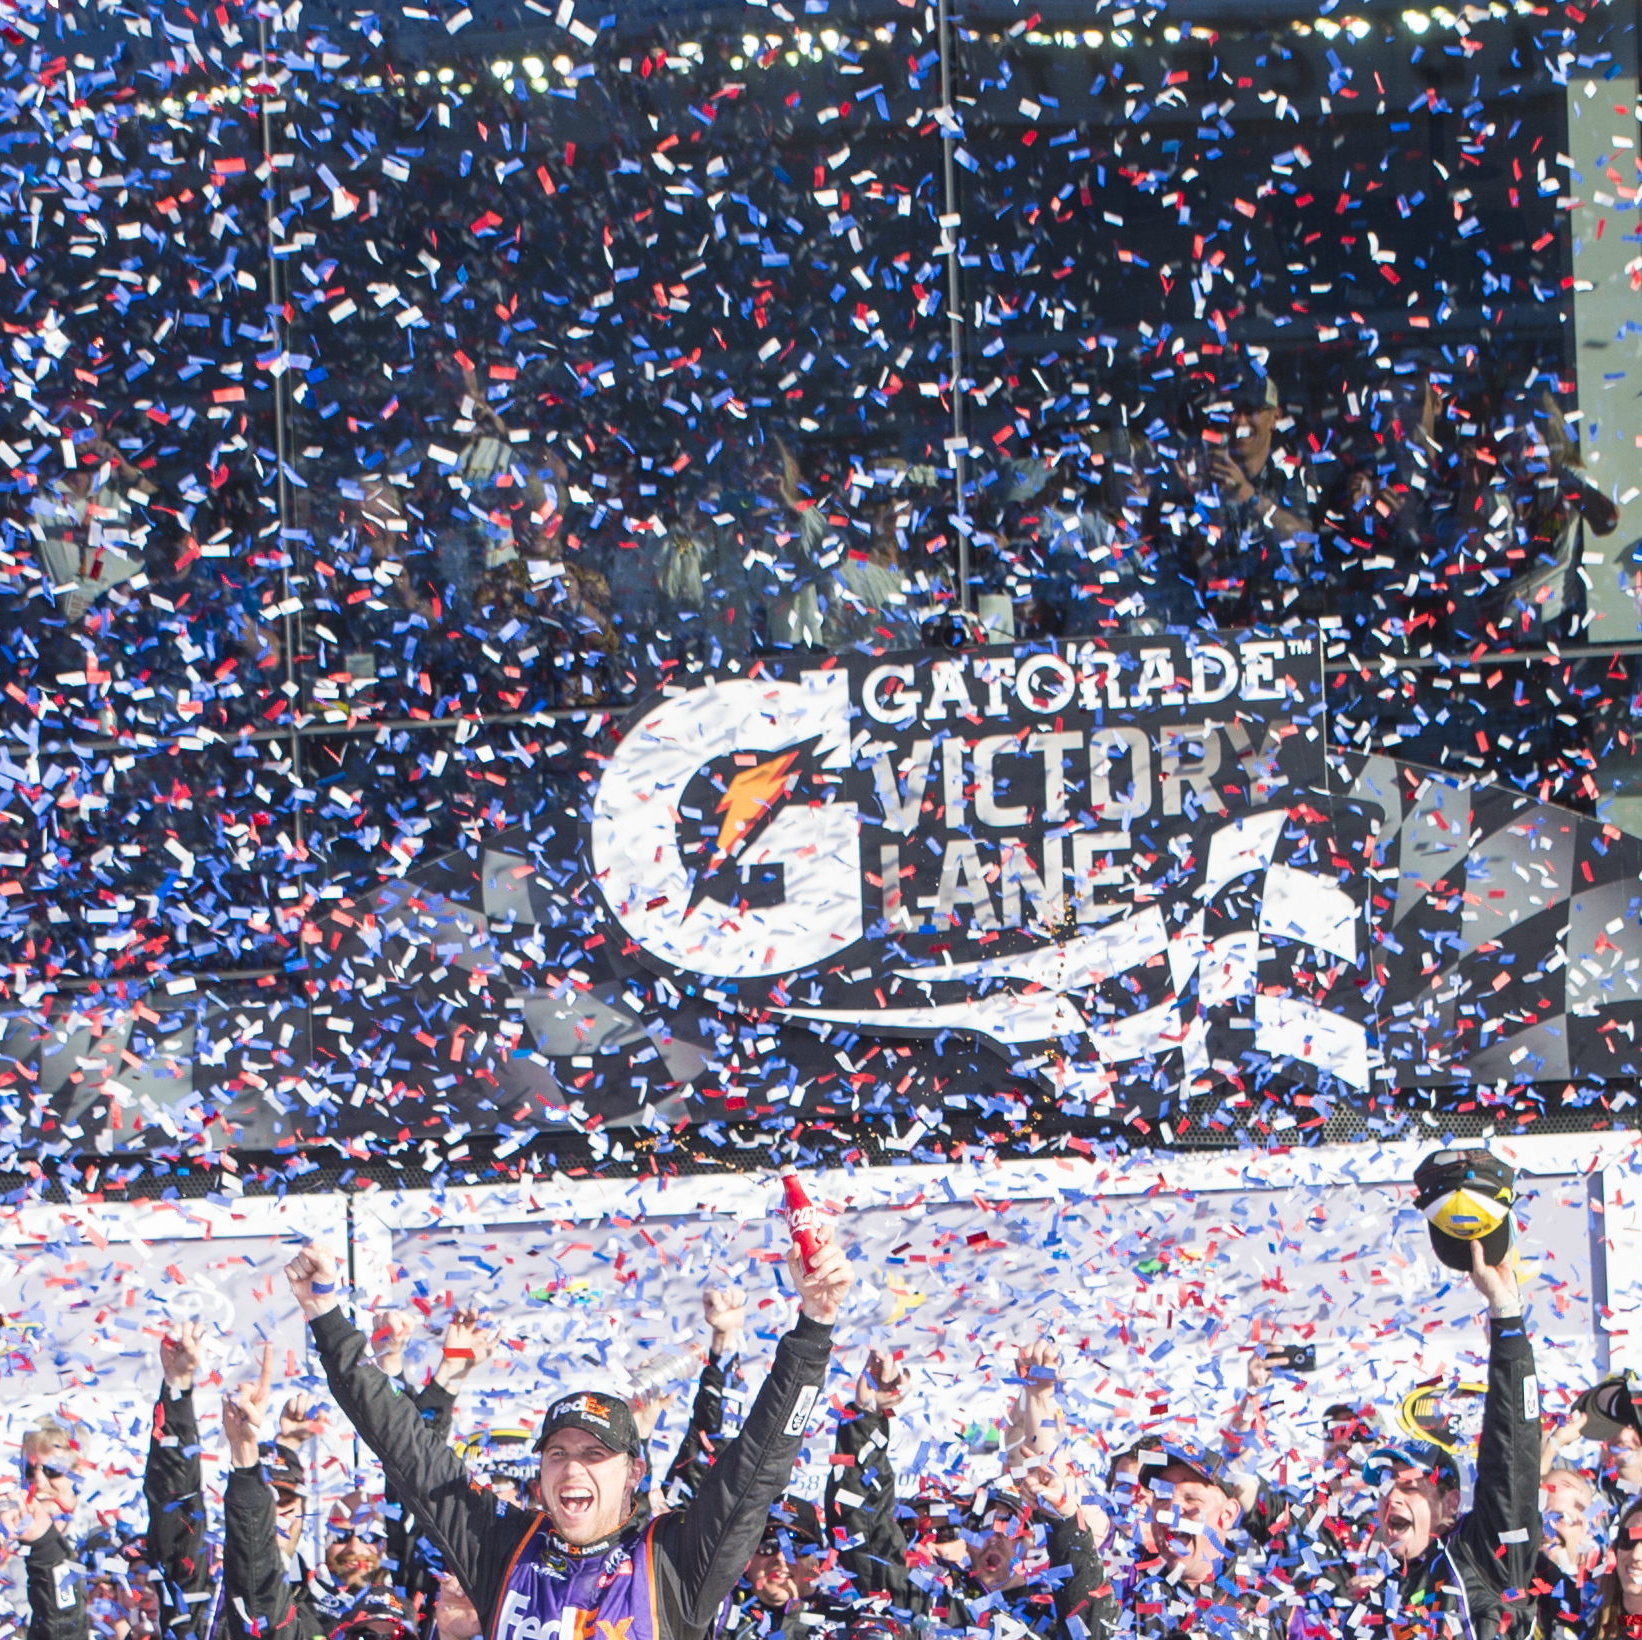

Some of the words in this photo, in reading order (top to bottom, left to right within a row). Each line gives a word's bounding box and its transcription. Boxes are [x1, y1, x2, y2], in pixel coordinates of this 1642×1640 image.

[861, 640, 1288, 724] GATORADE
[865, 720, 1287, 834] VICTORY
[881, 833, 1134, 934] LANE
